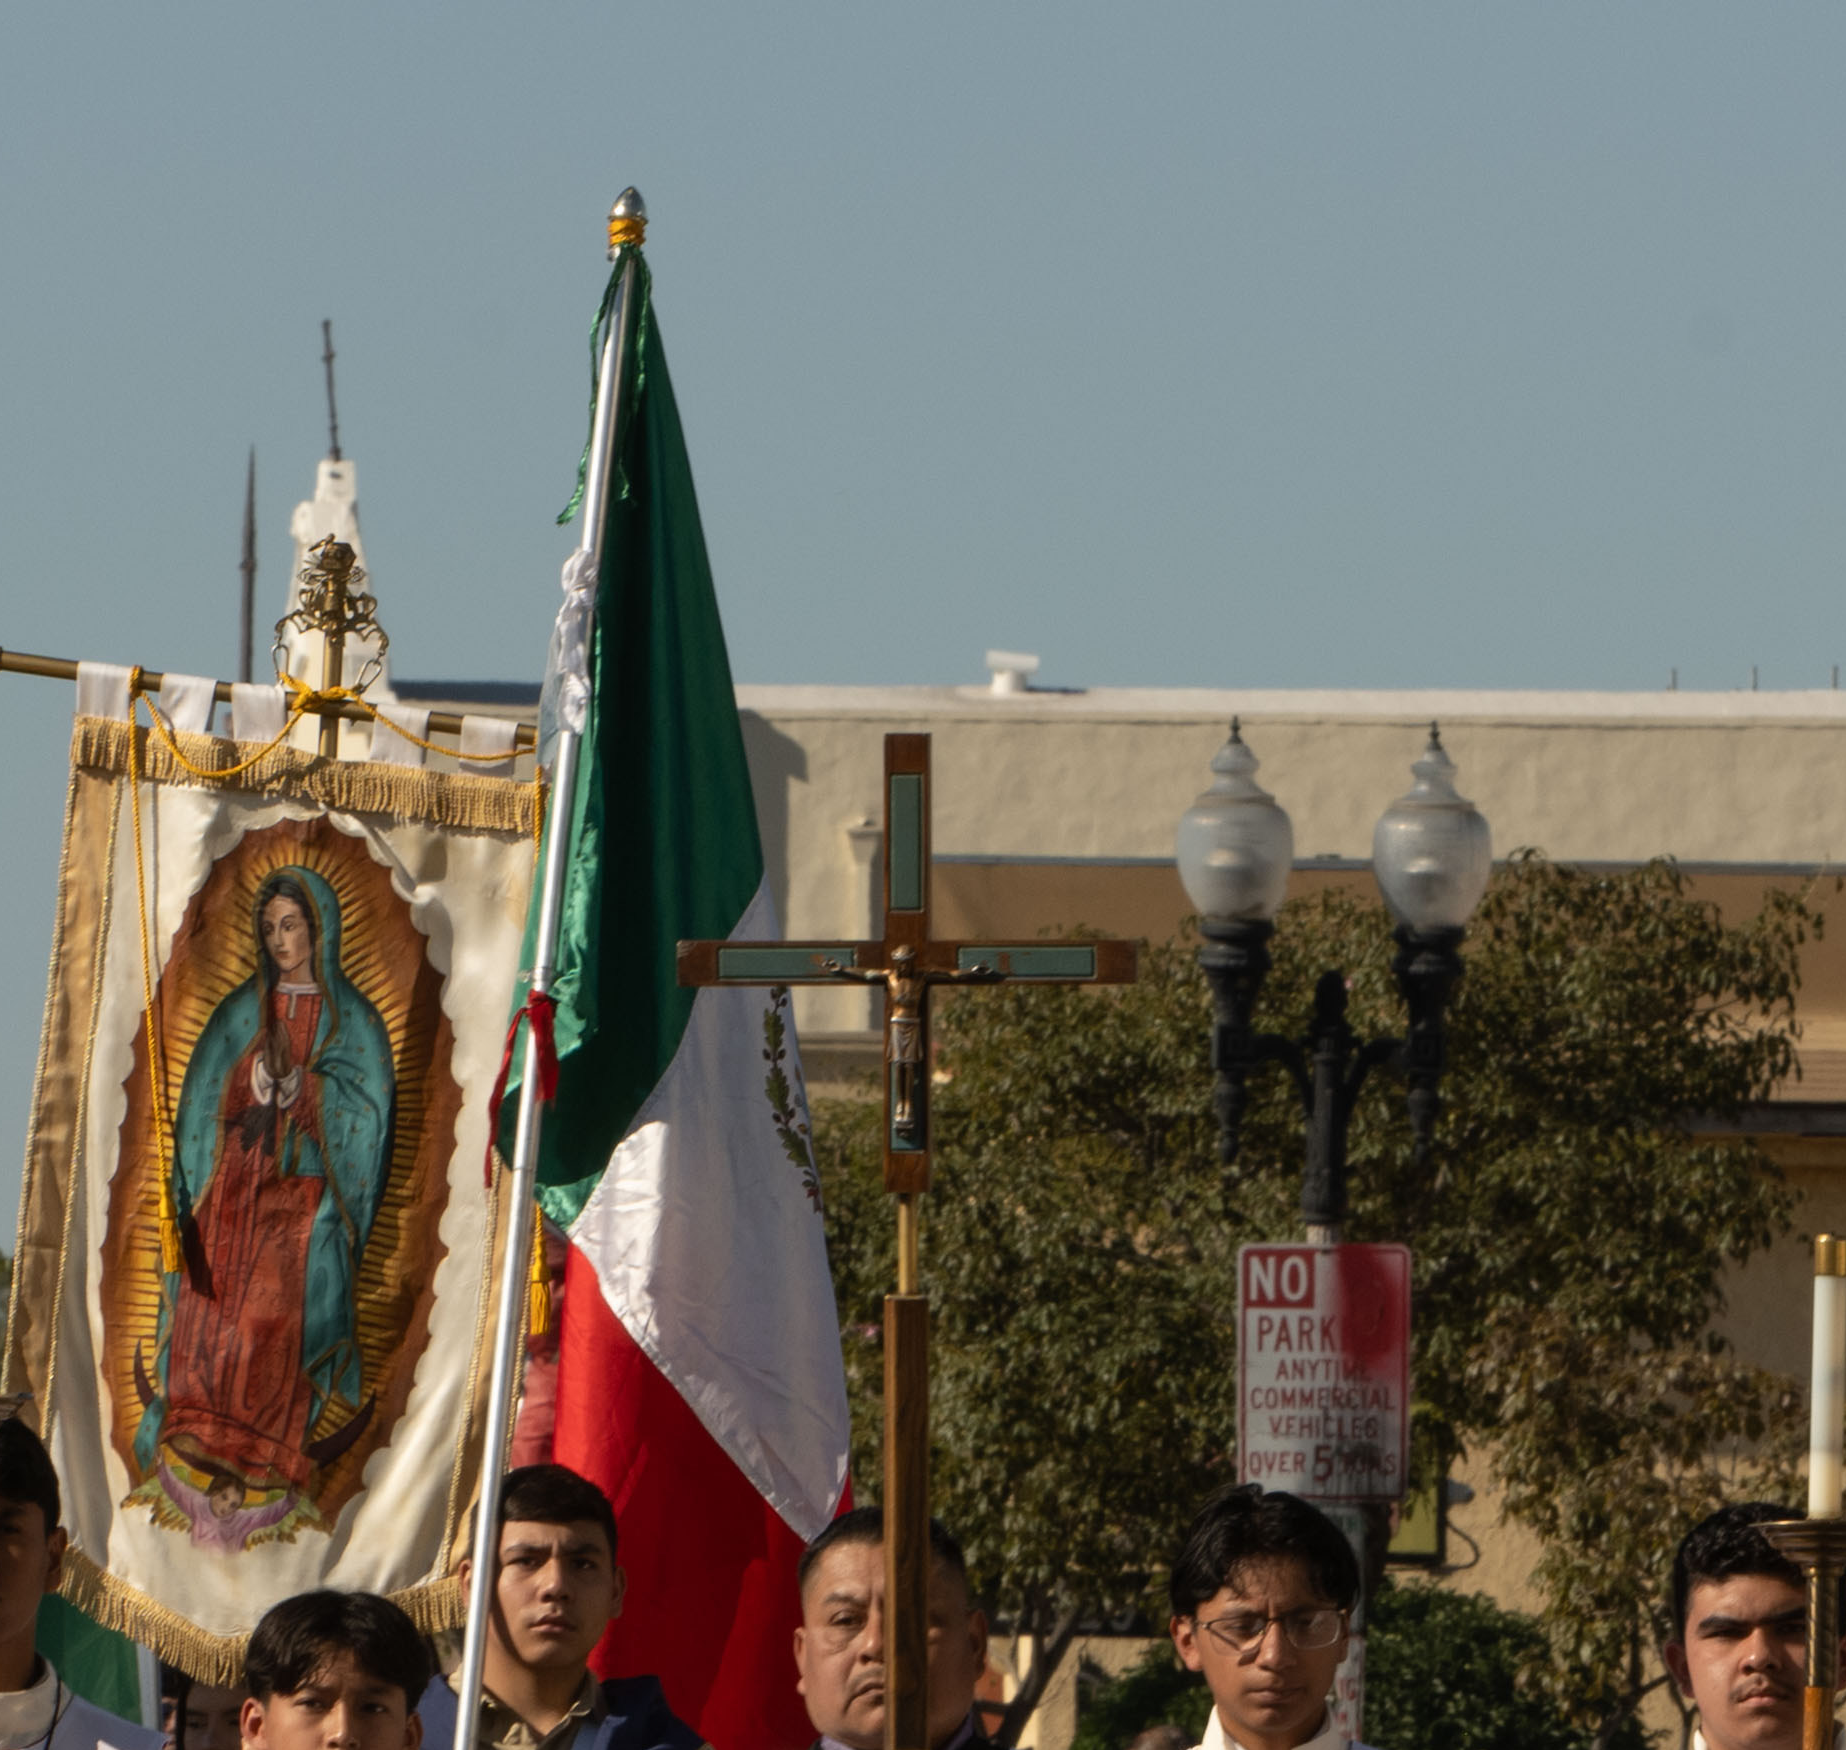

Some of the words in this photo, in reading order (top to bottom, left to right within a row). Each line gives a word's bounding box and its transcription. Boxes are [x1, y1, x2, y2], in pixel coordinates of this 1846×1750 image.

[1249, 1256, 1308, 1301] NO
[1258, 1315, 1338, 1352] PARK
[1250, 1387, 1396, 1411] COMMERCIAL
[1269, 1416, 1378, 1440] VEHICLES
[1249, 1452, 1306, 1475] OVER
[1313, 1444, 1334, 1482] 5
